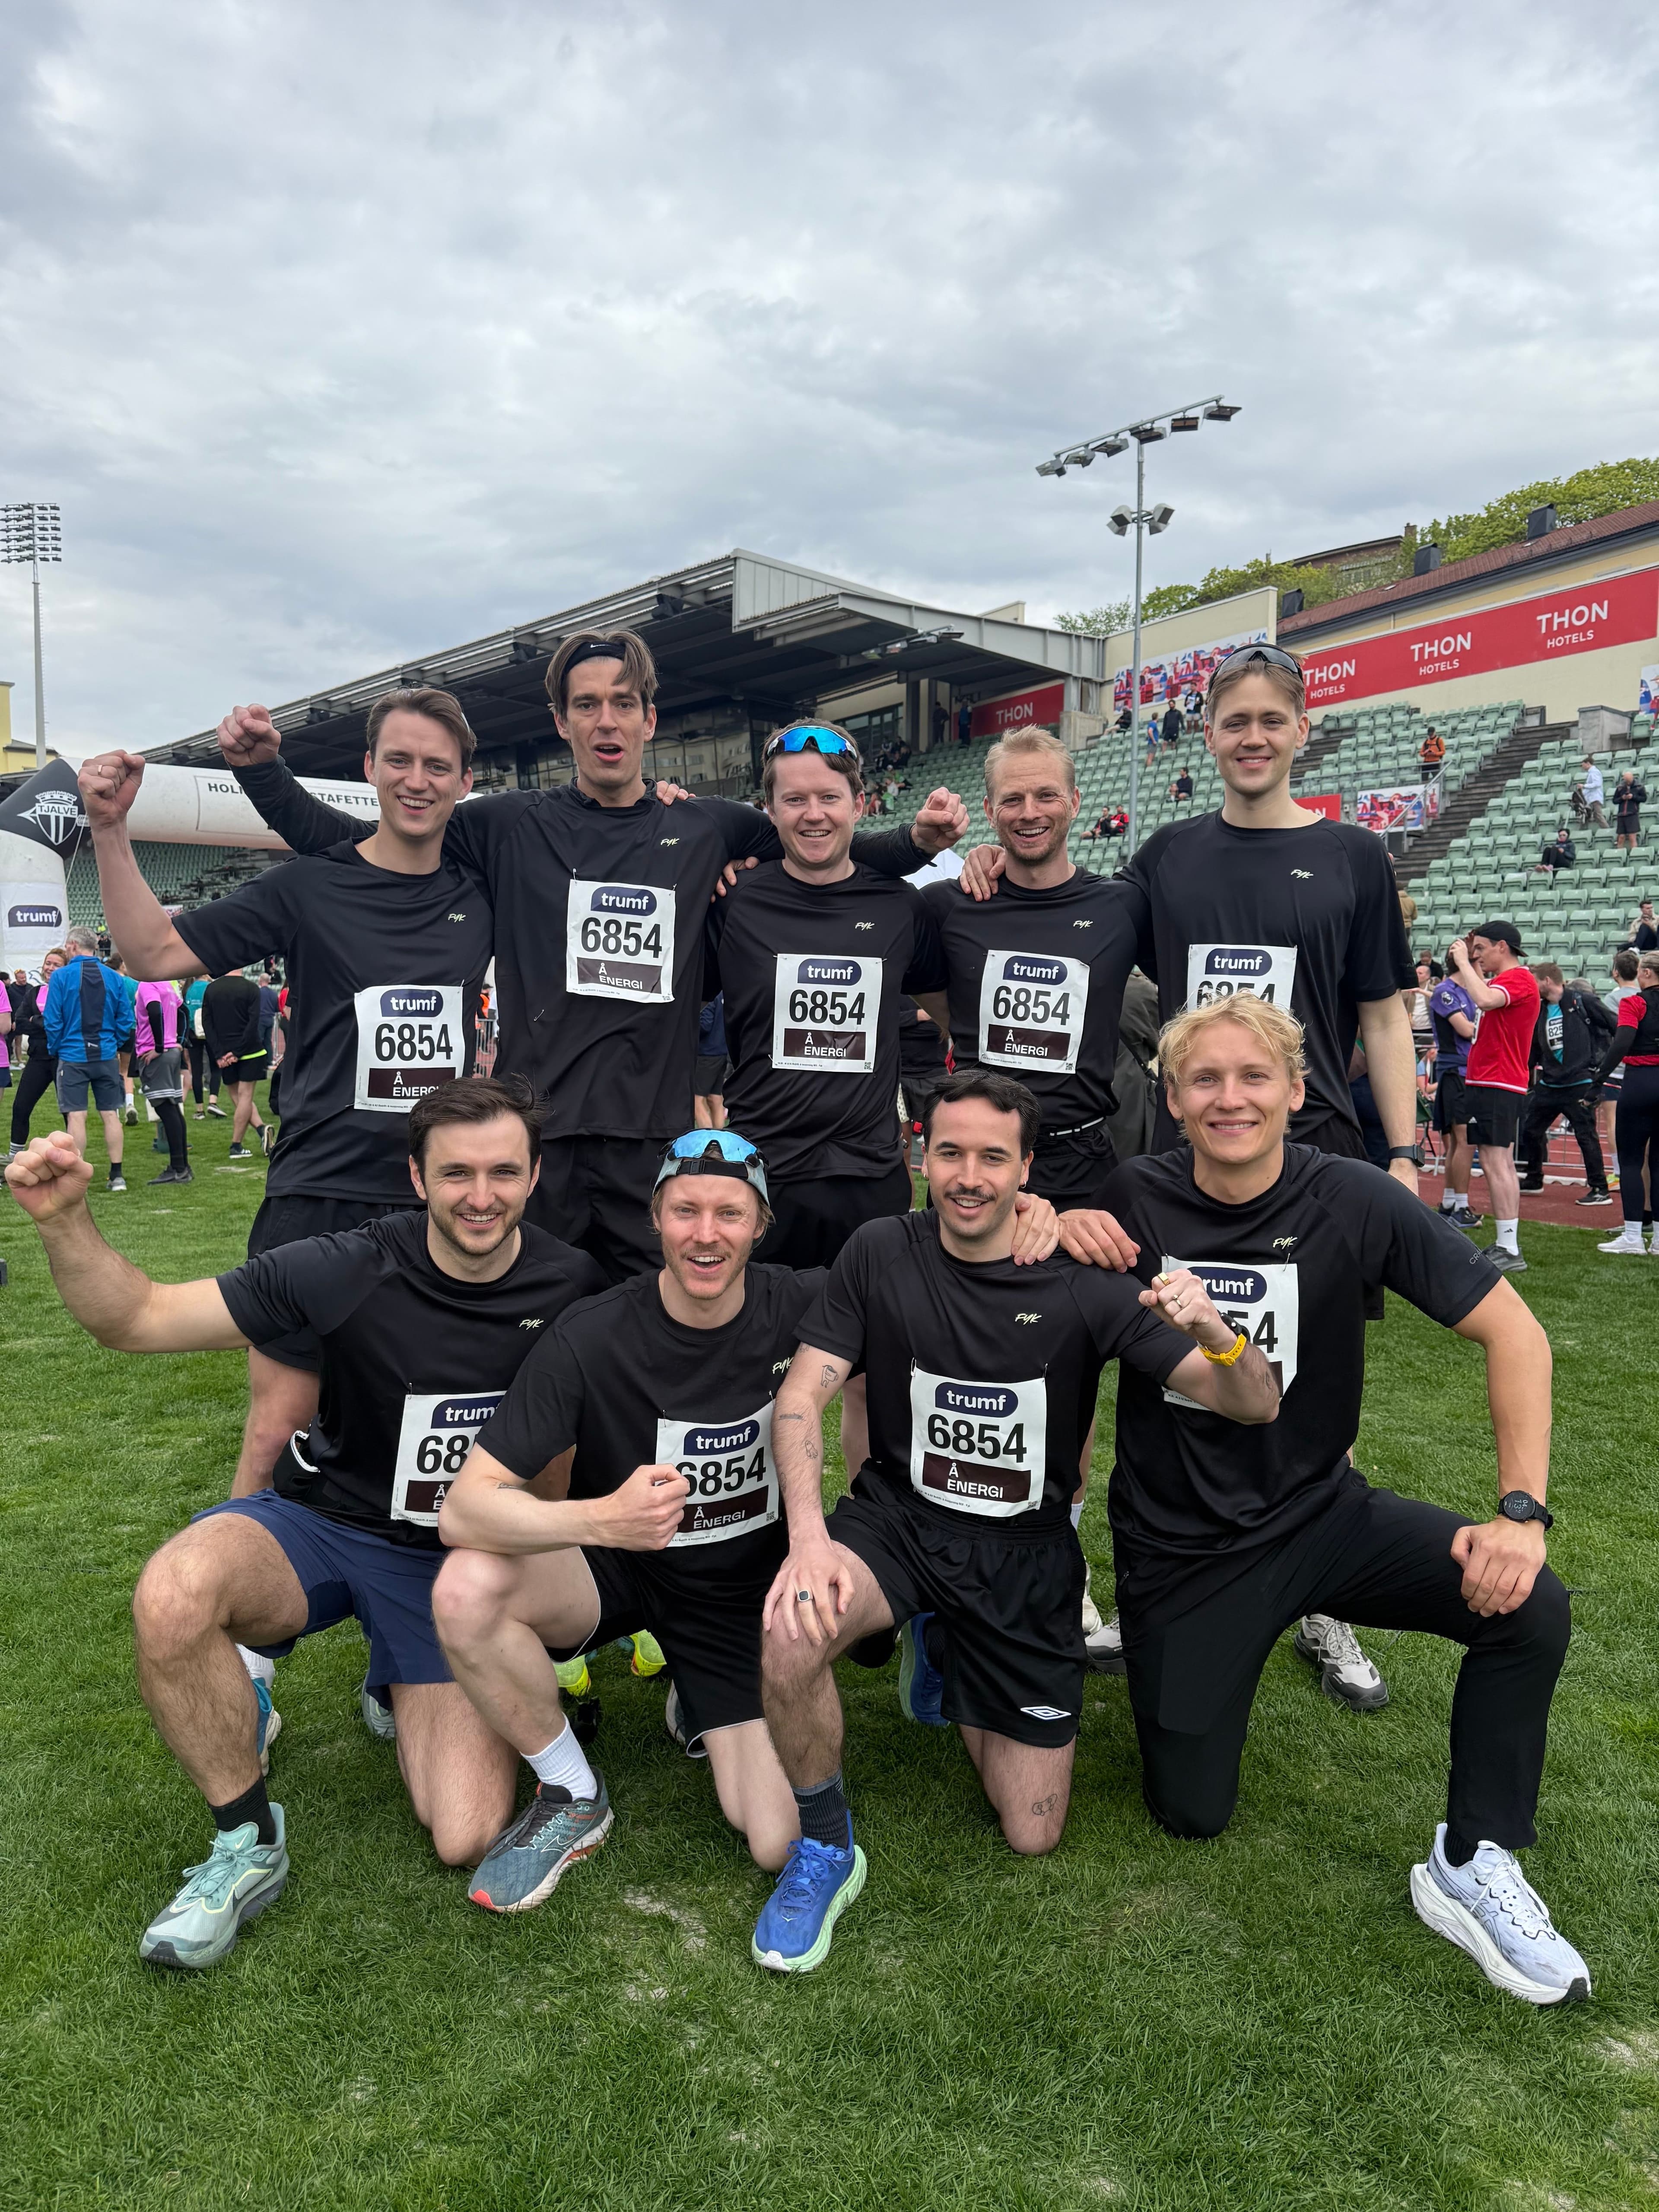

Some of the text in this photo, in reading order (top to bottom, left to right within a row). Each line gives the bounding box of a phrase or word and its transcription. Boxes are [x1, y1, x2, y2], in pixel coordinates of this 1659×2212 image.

[1537, 600, 1608, 634] THON
[1410, 632, 1471, 662] THON
[1547, 630, 1594, 648] HOTELS
[1303, 659, 1355, 686] THON
[1419, 658, 1459, 676] HOTELS
[1310, 684, 1345, 699] HOTELS
[996, 702, 1033, 725] THON
[38, 805, 77, 816] TJALVE
[601, 893, 649, 910] trumf
[16, 910, 57, 923] trumf
[581, 917, 662, 958] 6854
[598, 963, 607, 975] Å
[1013, 962, 1059, 979] trumf
[1214, 955, 1262, 970] trumf
[807, 965, 853, 980] trumf
[599, 975, 643, 989] ENERGI
[390, 996, 436, 1011] trumf
[789, 989, 865, 1025] 6854
[993, 985, 1070, 1026] 6854
[375, 1023, 453, 1062] 6854
[804, 1032, 814, 1045] Å
[1006, 1029, 1014, 1042] Å
[804, 1046, 846, 1057] ENERGI
[1004, 1043, 1048, 1057] ENERGI
[394, 1071, 404, 1085] Å
[392, 1086, 439, 1096] ENERG
[1203, 1278, 1254, 1296] rumf
[947, 1390, 1006, 1411] trumf
[445, 1404, 499, 1421] trum
[696, 1426, 751, 1449] trumf
[928, 1414, 1027, 1463] 6854
[417, 1435, 470, 1474] 68
[676, 1446, 766, 1498] 6854
[948, 1462, 959, 1478] Å
[435, 1484, 446, 1498] Å
[947, 1479, 1004, 1499] ENERGI
[693, 1510, 745, 1529] ENERGI
[694, 1506, 705, 1519] Å
